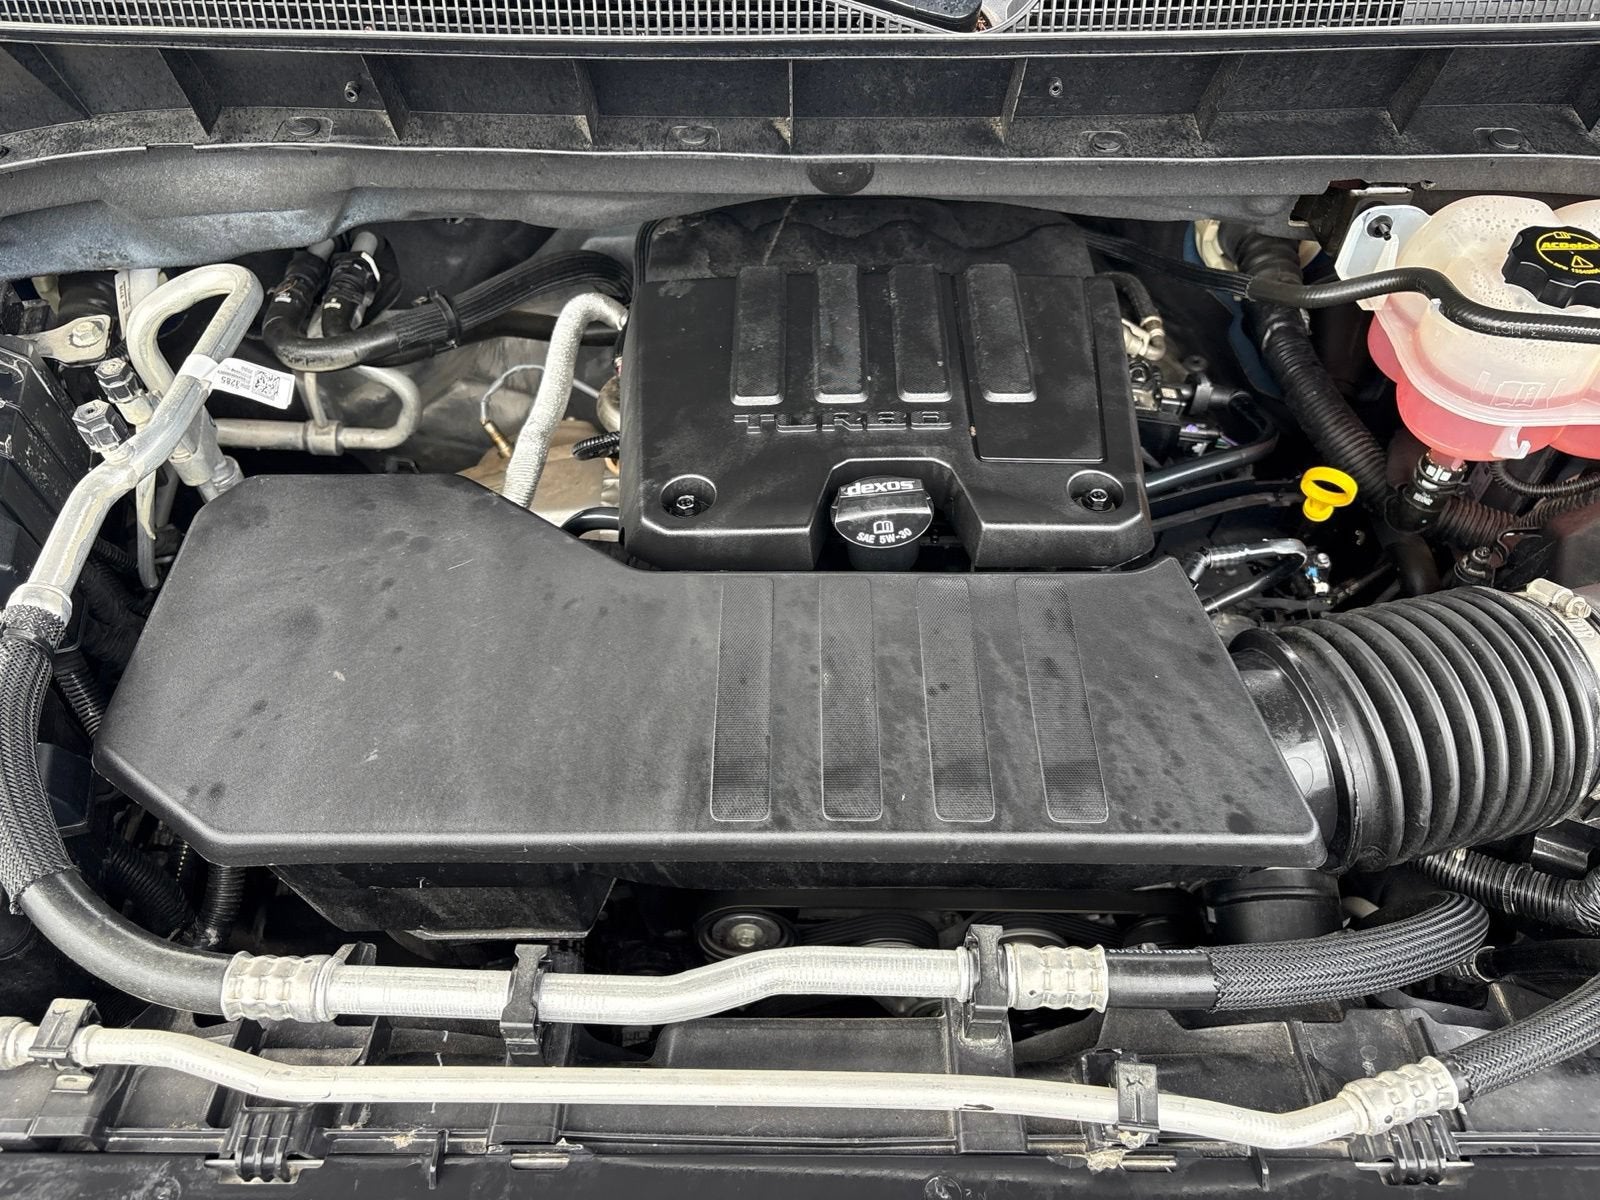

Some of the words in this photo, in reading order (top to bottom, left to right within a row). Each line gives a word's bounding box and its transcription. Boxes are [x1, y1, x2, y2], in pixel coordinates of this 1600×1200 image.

[1540, 242, 1600, 250] ACDelco
[733, 410, 952, 433] TURBO
[843, 480, 916, 496] dexos
[856, 532, 876, 544] SAE
[879, 527, 913, 544] 5W-30
